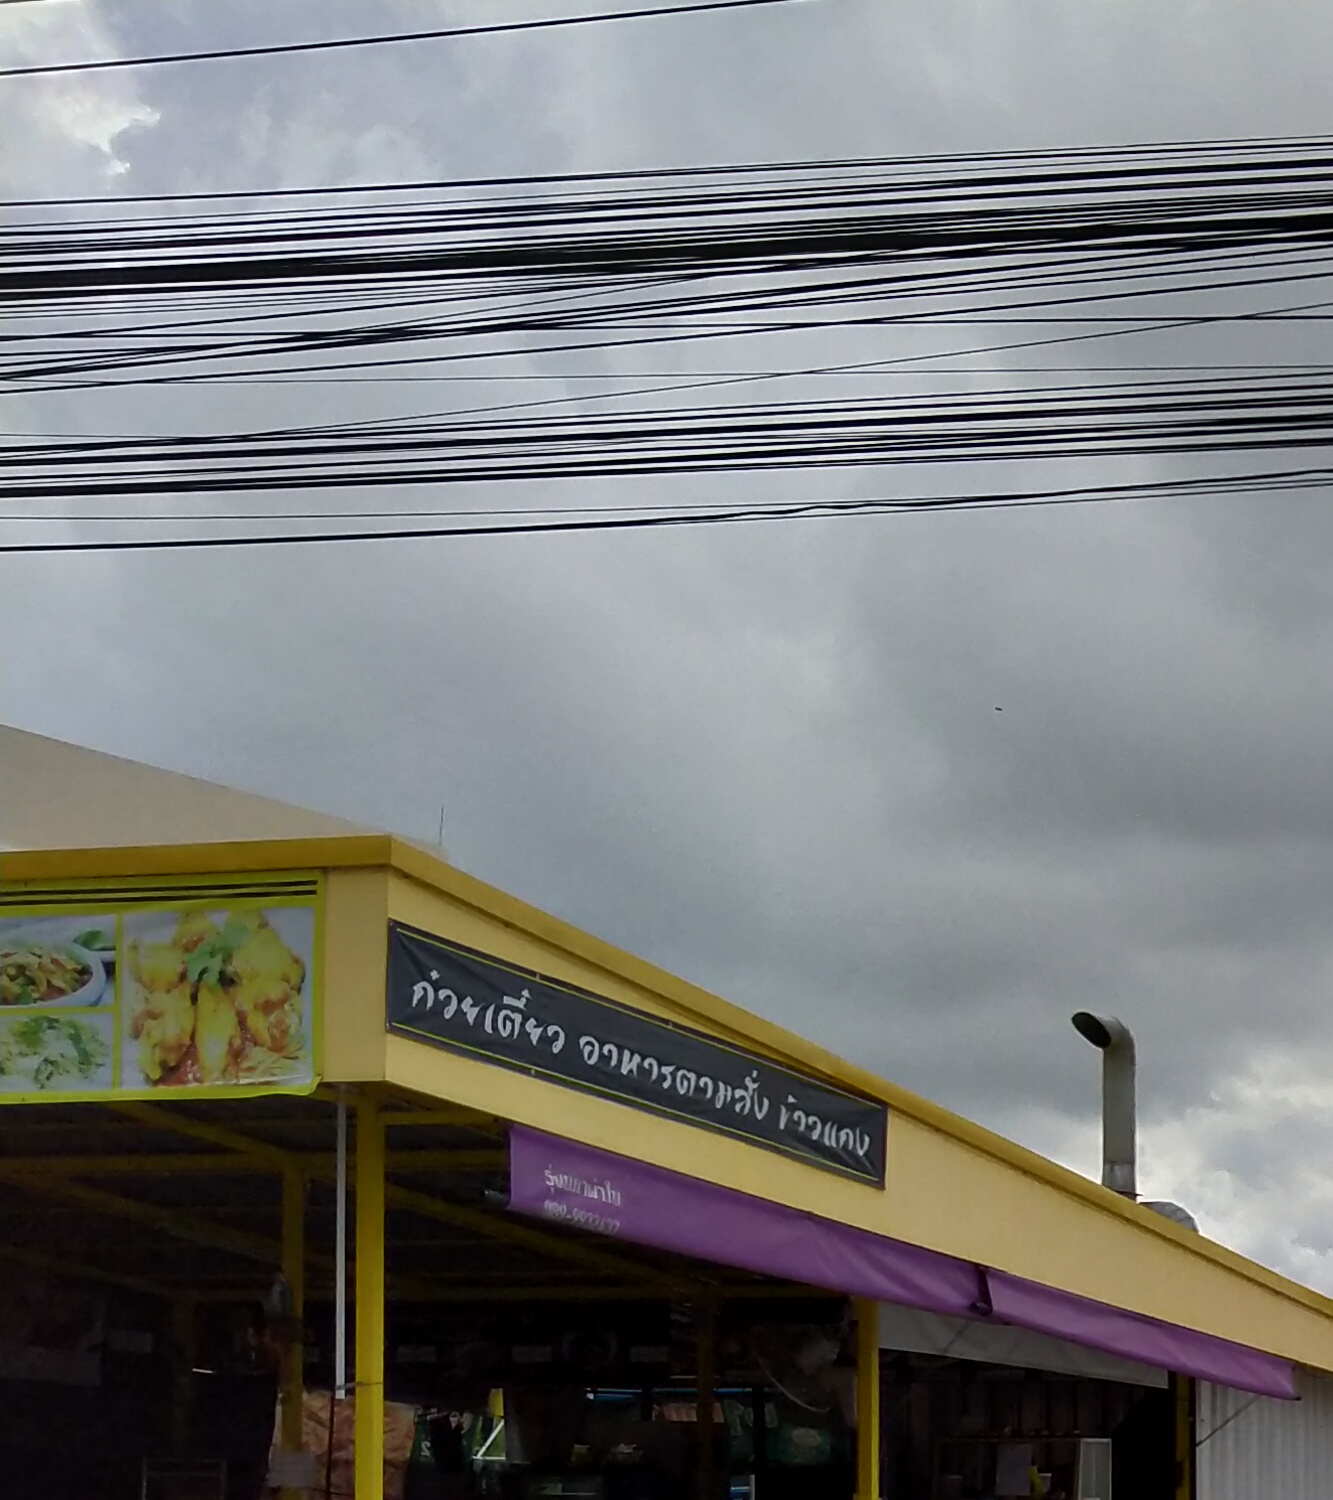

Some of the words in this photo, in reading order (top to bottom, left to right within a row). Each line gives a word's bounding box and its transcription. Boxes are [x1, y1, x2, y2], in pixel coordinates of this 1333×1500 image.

[412, 969, 566, 1054] ก๋วยเตี๋ยว
[579, 1034, 770, 1120] อาหารตามสั่ง
